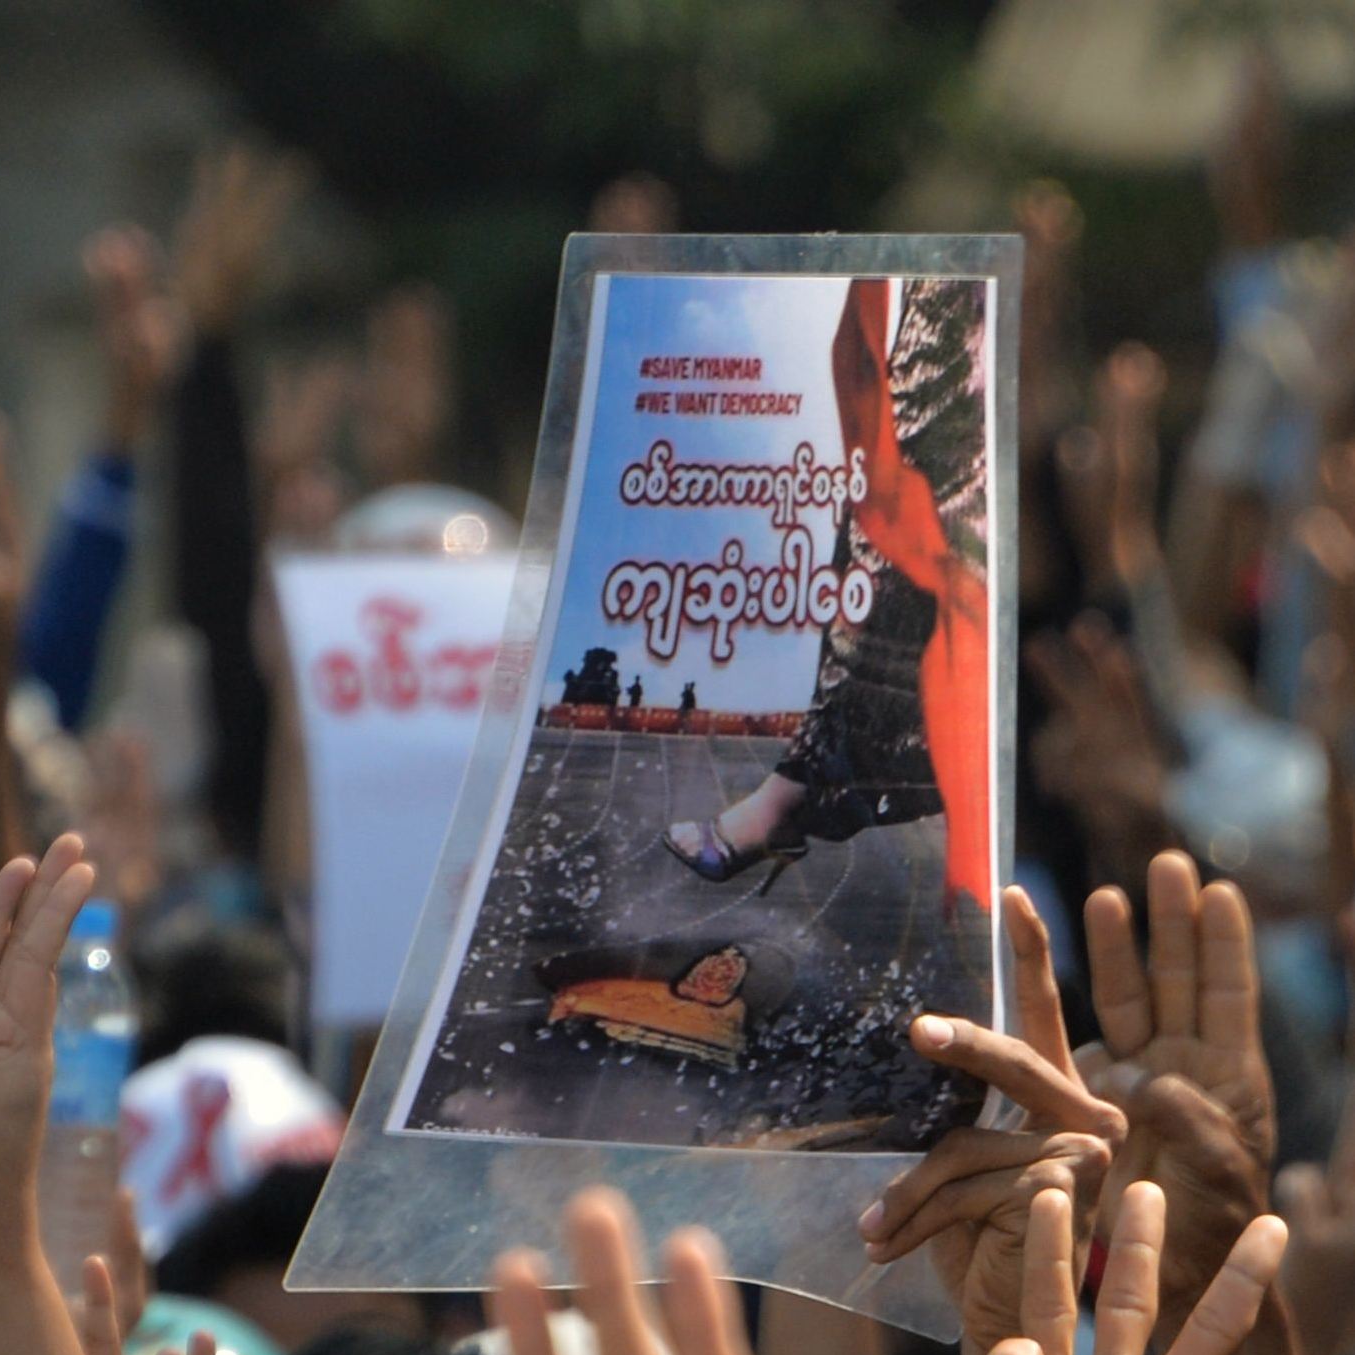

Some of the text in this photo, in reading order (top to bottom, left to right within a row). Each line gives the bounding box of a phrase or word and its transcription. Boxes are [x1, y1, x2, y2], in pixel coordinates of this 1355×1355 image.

[640, 357, 762, 380] #SAVE MYANMAR
[635, 391, 803, 415] #WE WANT DEMOCRACY
